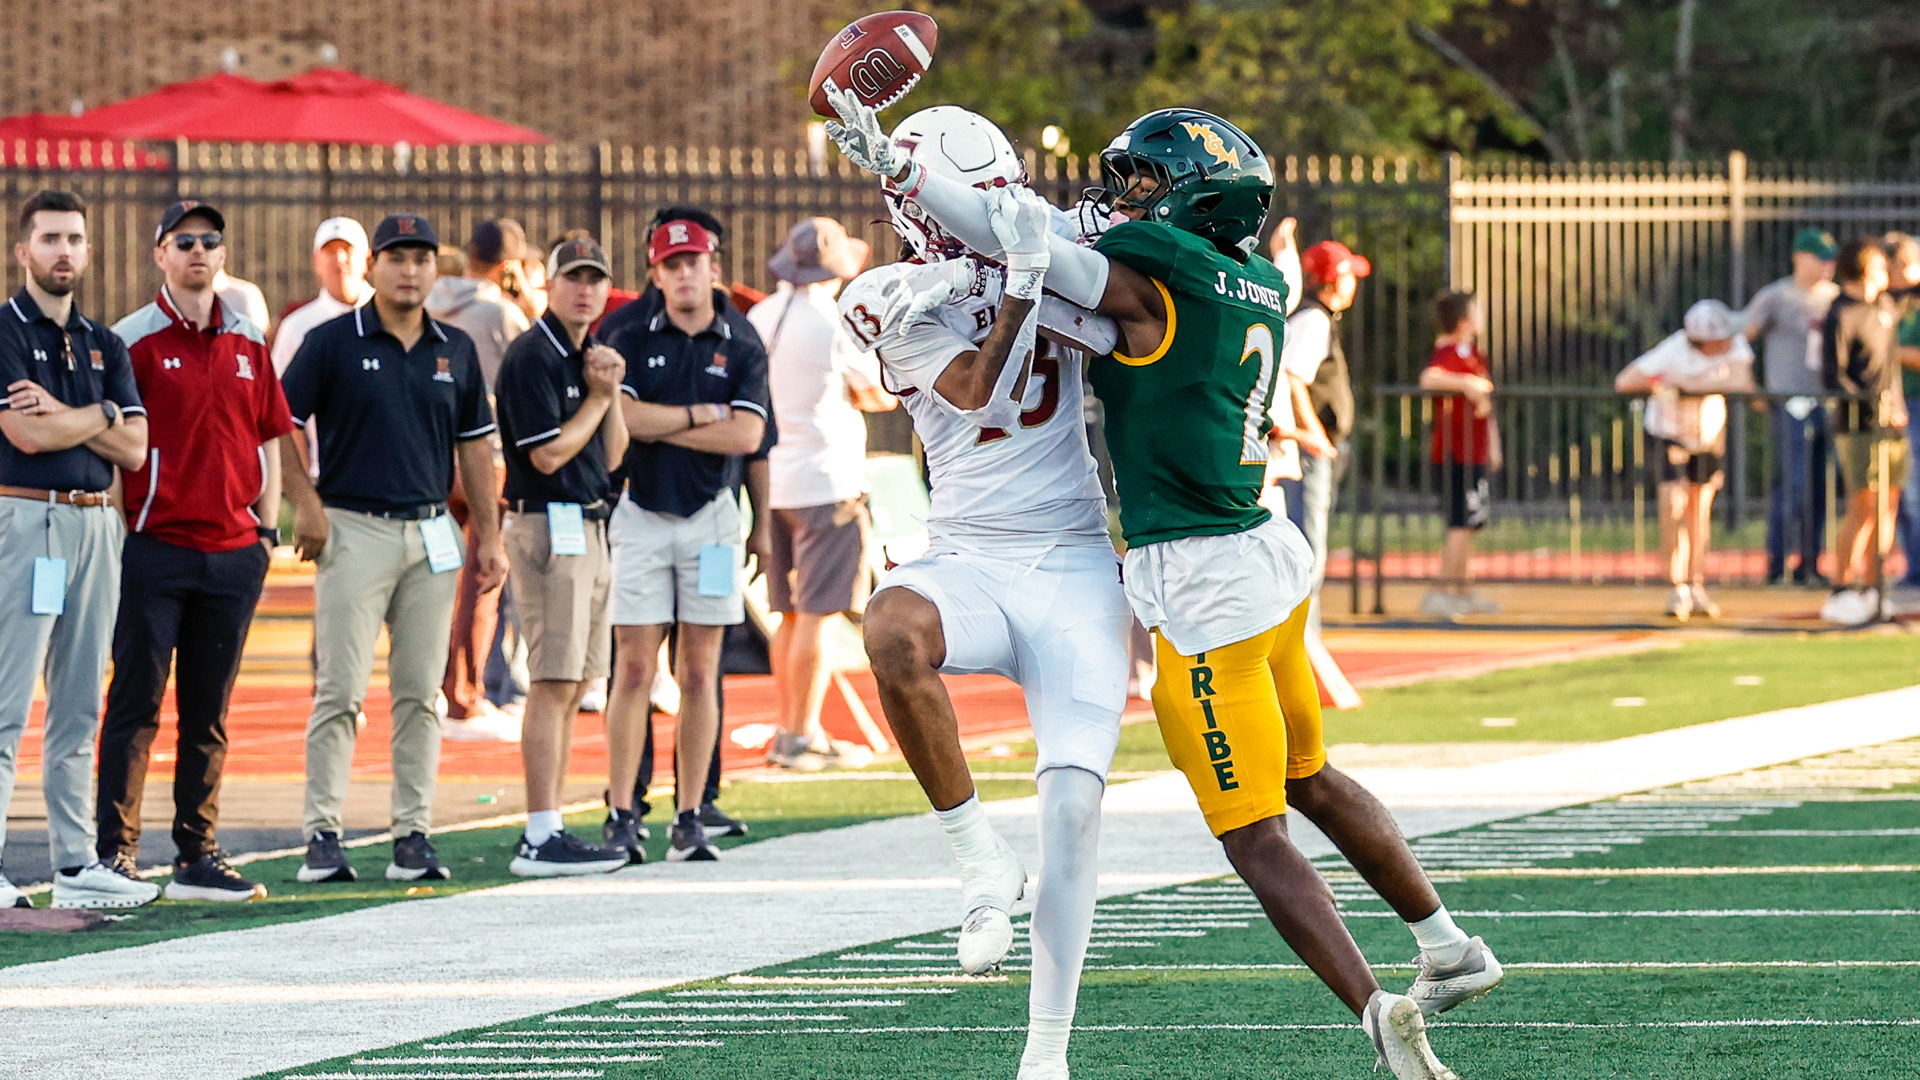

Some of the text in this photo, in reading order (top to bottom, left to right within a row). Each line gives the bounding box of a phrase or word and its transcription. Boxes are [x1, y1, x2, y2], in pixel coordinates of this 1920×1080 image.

[843, 303, 882, 346] 13
[1239, 322, 1274, 466] 2
[1189, 652, 1239, 792] RIBE
